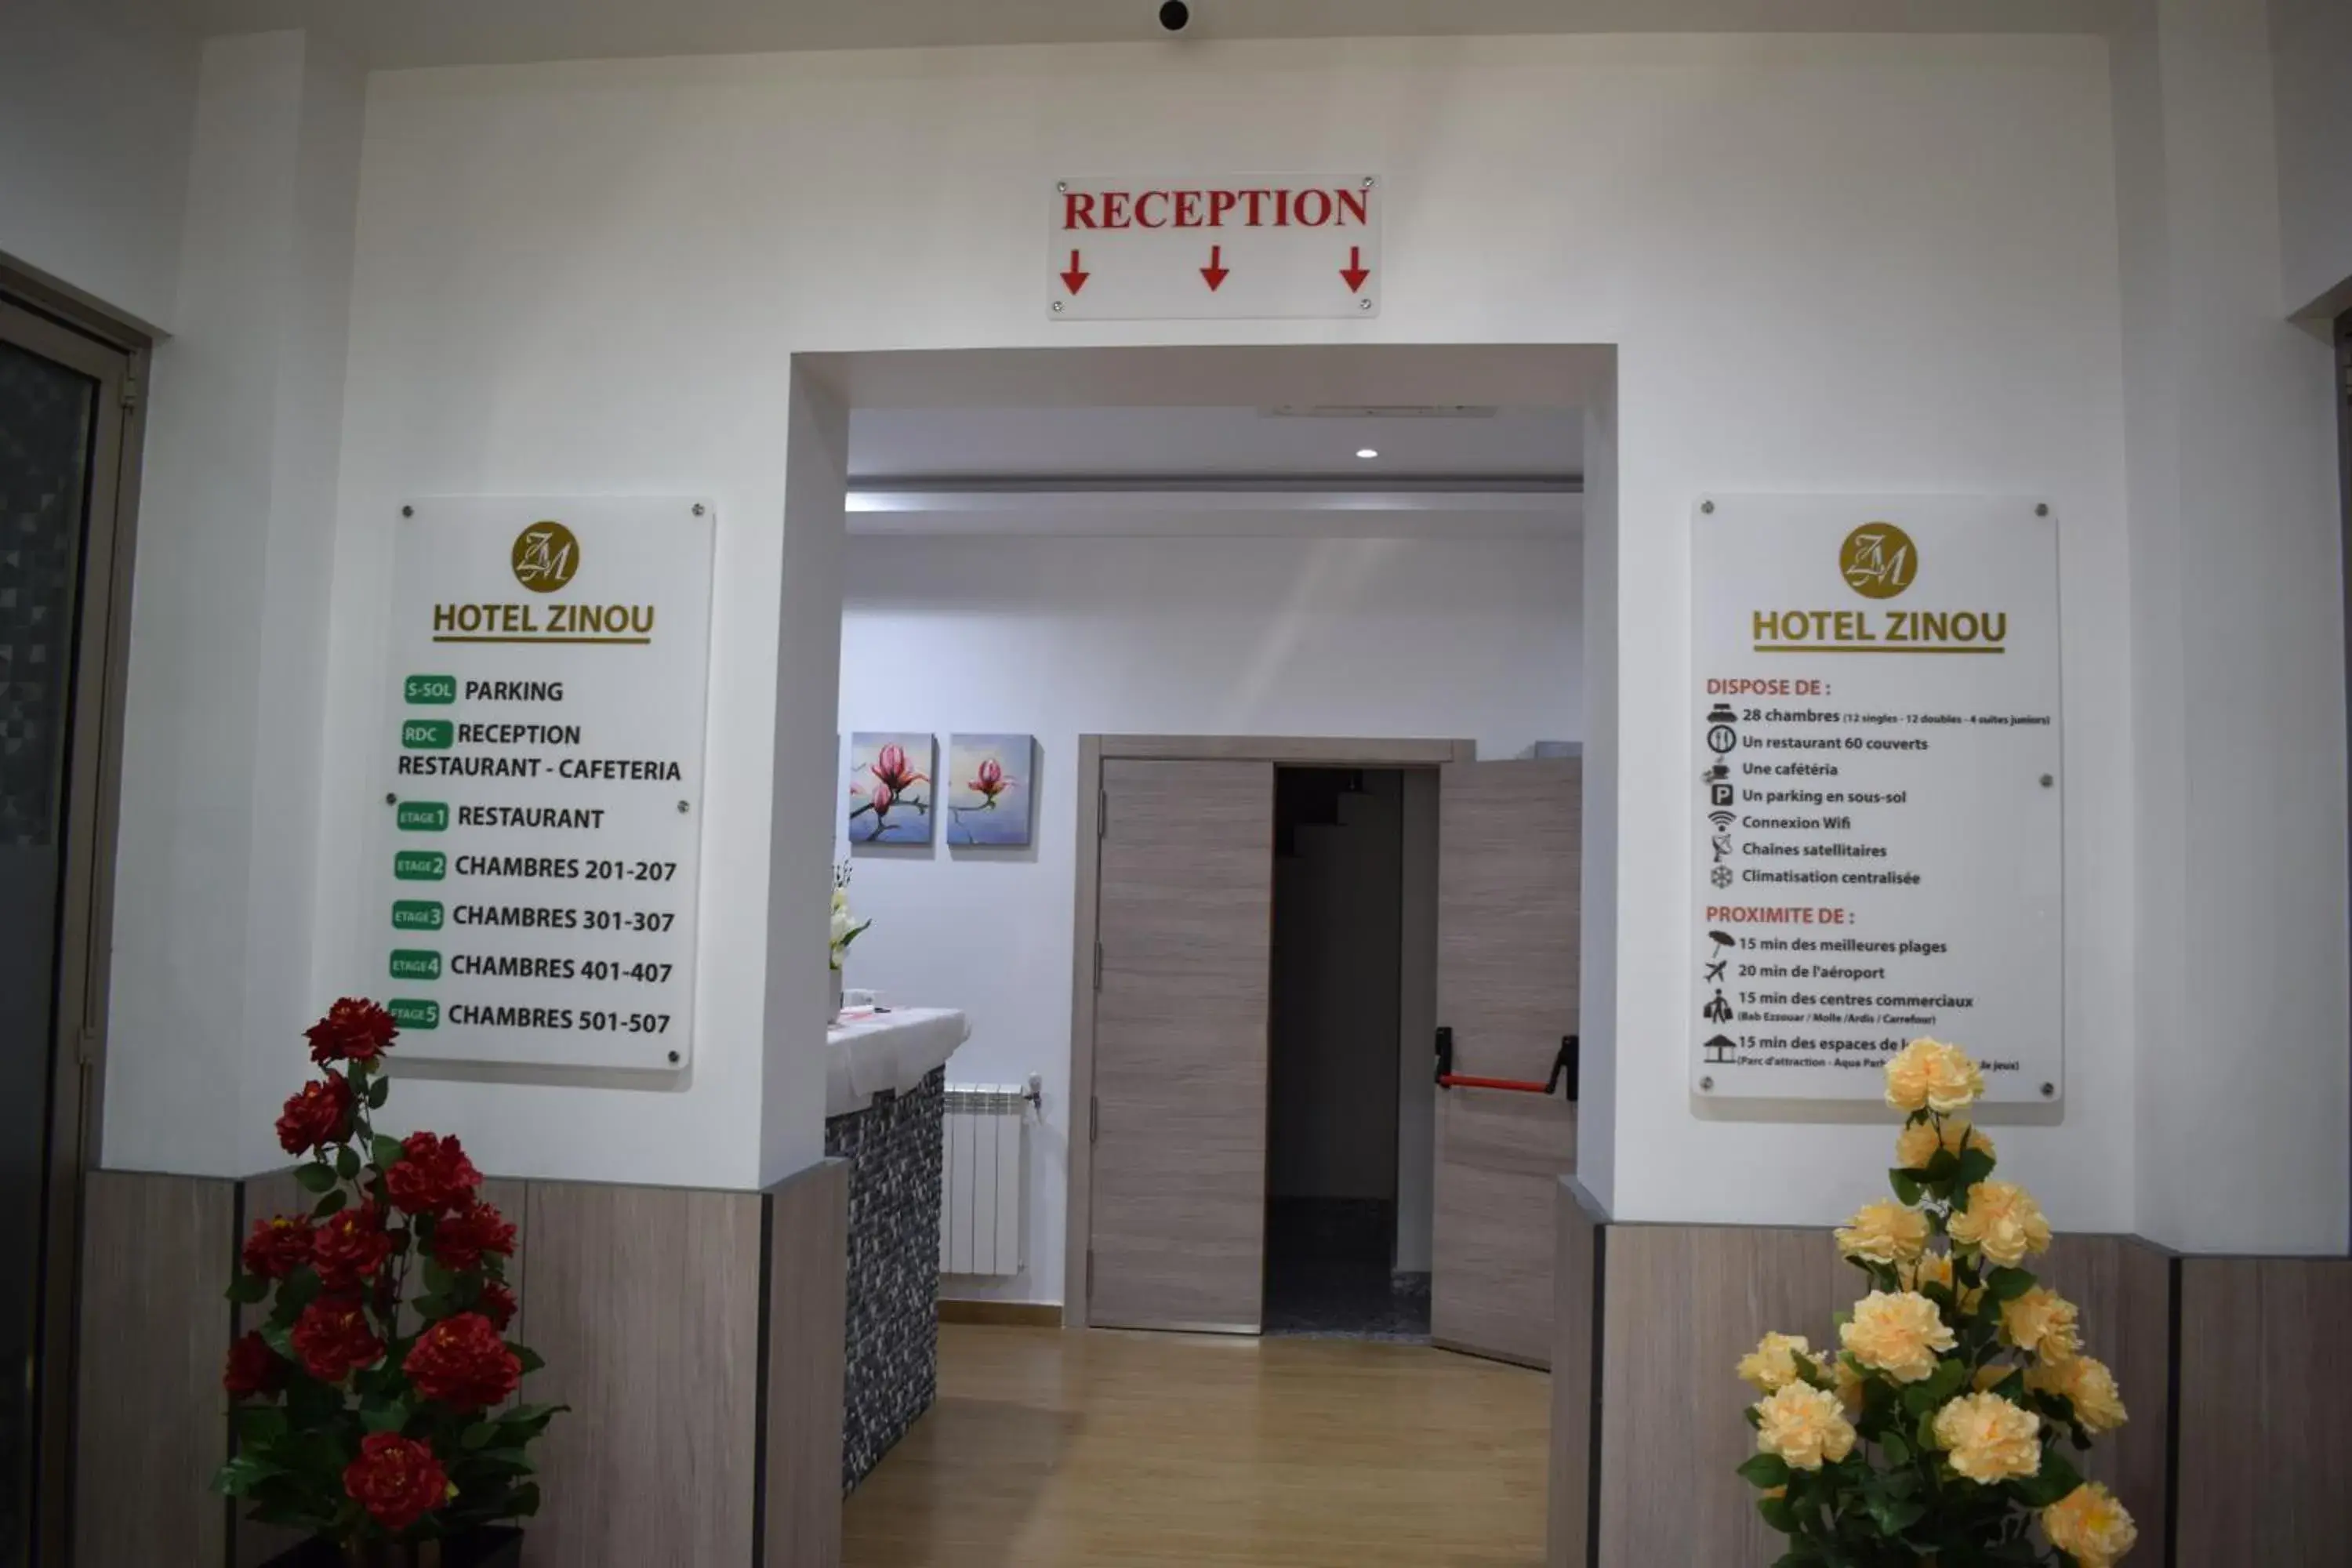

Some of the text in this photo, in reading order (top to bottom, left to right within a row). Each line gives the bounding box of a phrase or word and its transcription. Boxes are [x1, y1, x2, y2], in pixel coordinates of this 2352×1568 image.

[1062, 188, 1370, 230] RECEPTION
[434, 604, 653, 633] HOTEL ZINOU
[1755, 612, 2005, 641] HOTEL ZINOU
[409, 681, 562, 701] S-SOL PARKING
[1708, 679, 1789, 695] DISPOSE
[1795, 680, 1820, 695] DE
[1744, 710, 1761, 721] 28
[1766, 709, 1839, 721] chambres
[1862, 715, 1897, 724] singles
[406, 724, 579, 744] RDC RECEPTION
[1743, 736, 1928, 750] Un restaurant 60 couverts
[399, 756, 541, 776] RESTAURANT
[559, 759, 681, 780] CAFETERIA
[1743, 763, 1838, 775] Une cafétéria
[1743, 790, 1762, 800] Un
[1767, 790, 1822, 805] parking
[1827, 793, 1843, 802] en
[1849, 791, 1906, 803] sous-sol
[401, 806, 604, 828] ETAGE 1 RESTAURANT
[1743, 816, 1850, 829] Connexion Wifi
[1804, 844, 1886, 857] satellitaires
[397, 856, 676, 880] ETAGE 2 CHAMBRES 201-207
[1743, 870, 1920, 884] Climatisation centralisée
[395, 906, 674, 931] ETAGE 3 CHAMBRES 301-307
[1708, 906, 1813, 924] PROXIMITE
[1819, 908, 1843, 924] DE
[1740, 938, 1947, 956] 15 min des meilleures plages
[429, 958, 438, 973] 4
[452, 955, 574, 978] CHAMBRES
[581, 961, 672, 982] 401-407
[1739, 964, 1884, 981] 20 min de l'aéroport
[1740, 993, 1973, 1007] 15 min des centres commerciaux
[427, 1007, 436, 1022] 5
[448, 1005, 572, 1029] CHAMBRES
[579, 1011, 670, 1033] 501-507
[1740, 1036, 1755, 1048] 15
[1760, 1037, 1787, 1048] min
[1791, 1036, 1816, 1049] des
[1820, 1041, 1876, 1052] espaces
[1880, 1039, 1897, 1051] de
[1835, 1058, 1860, 1069] Aqua
